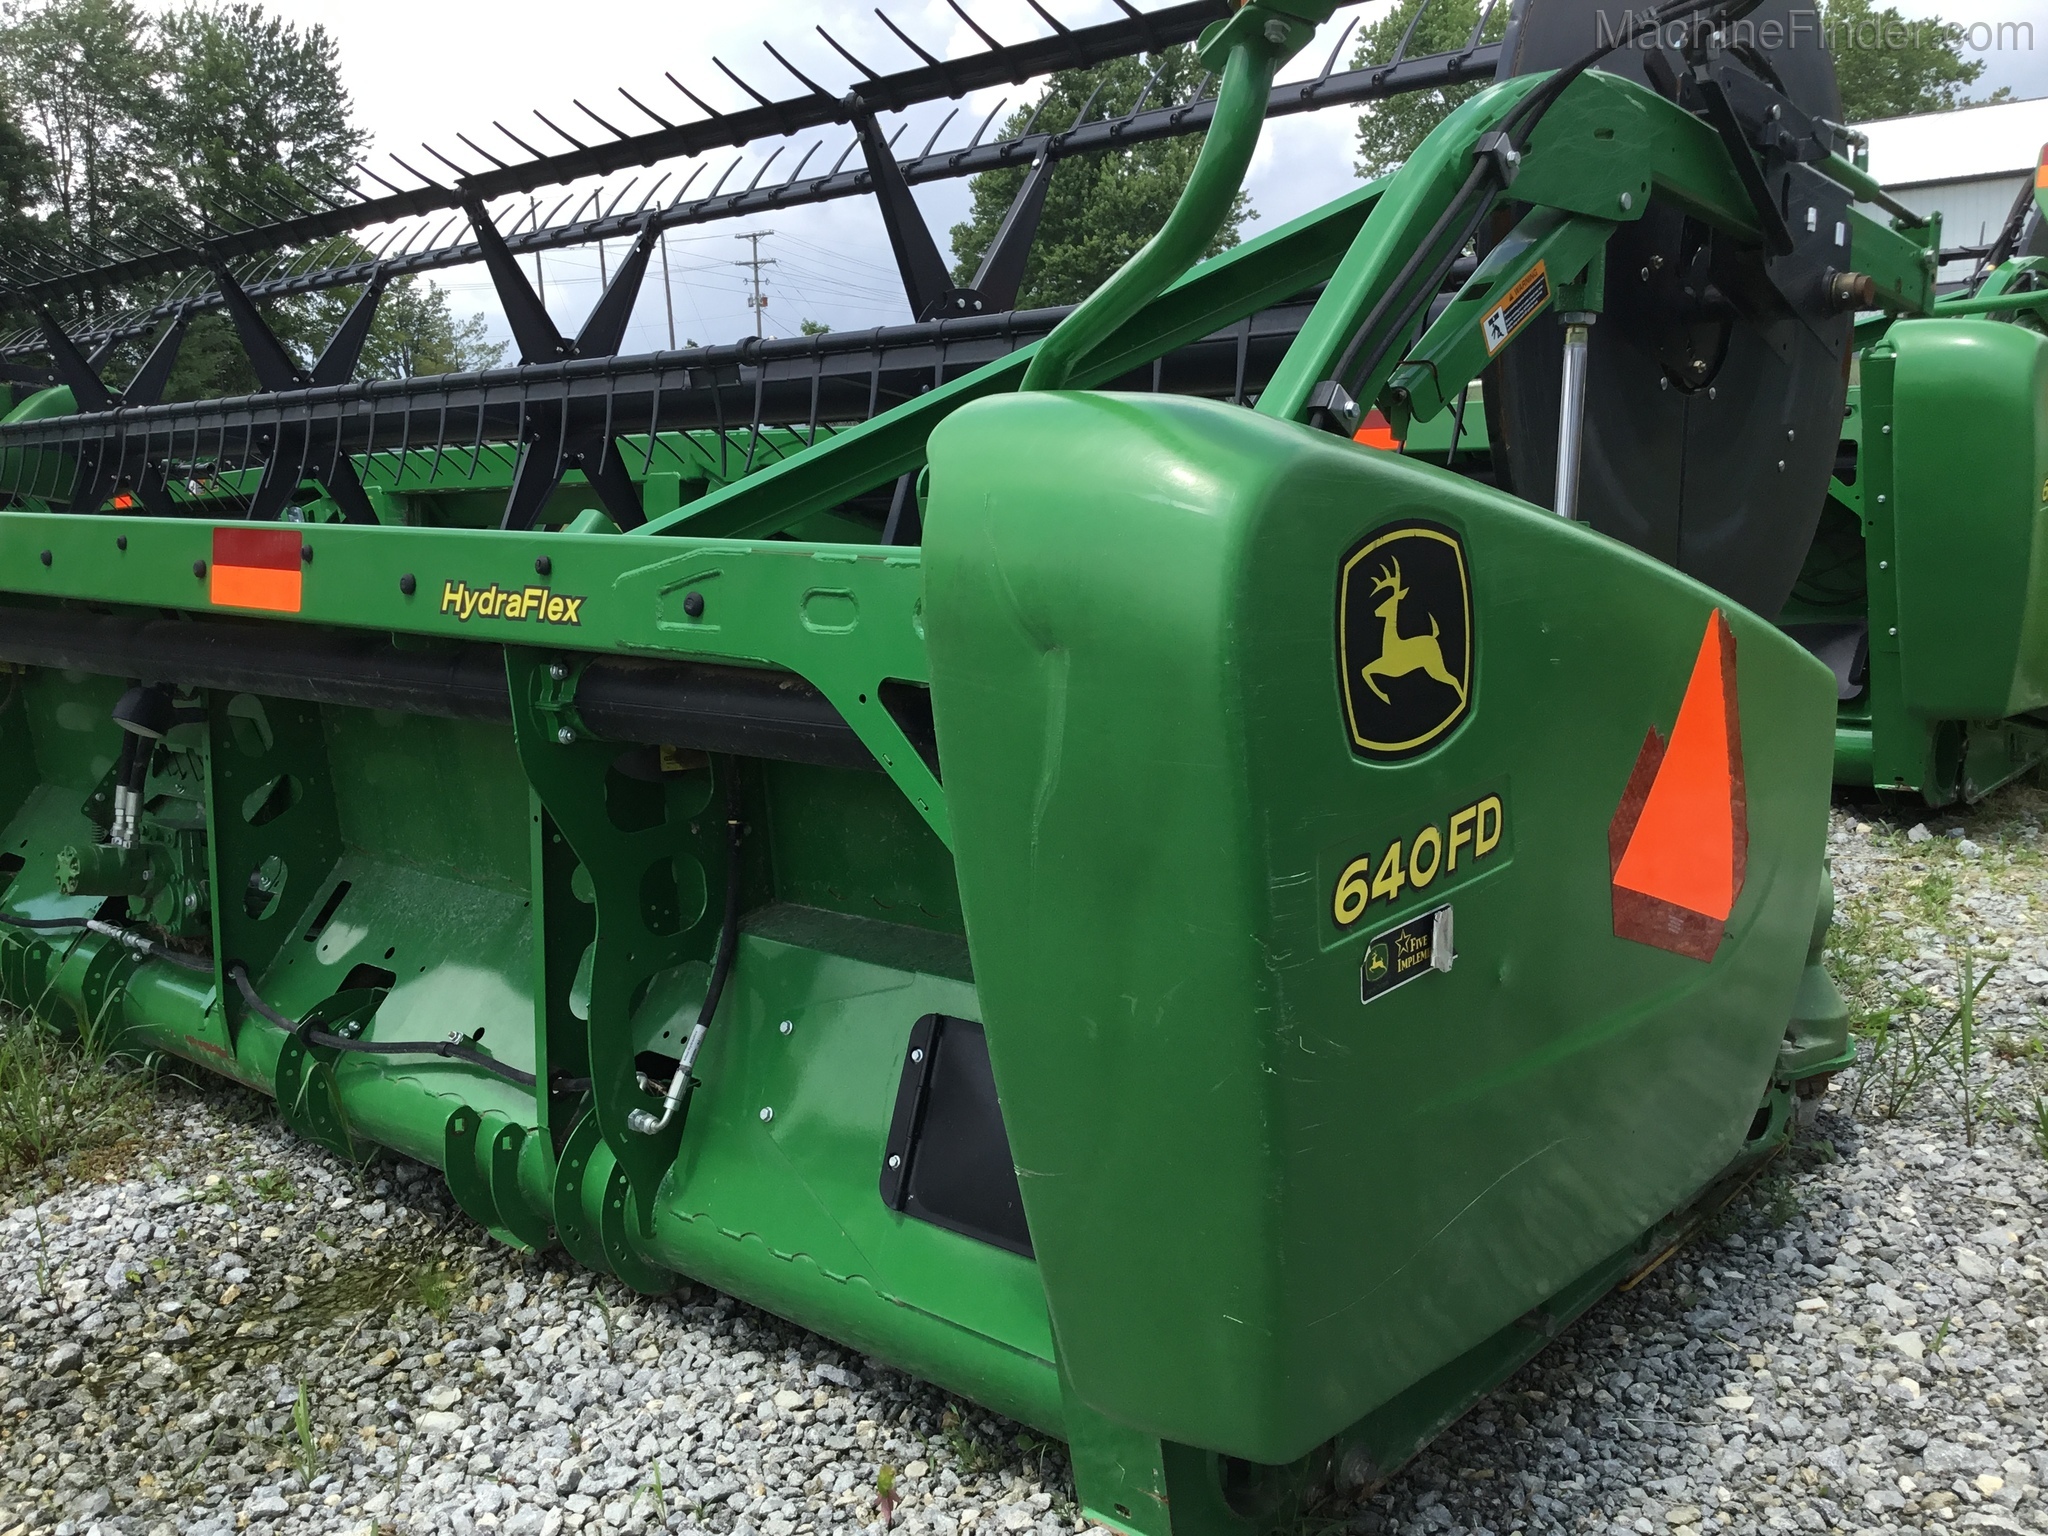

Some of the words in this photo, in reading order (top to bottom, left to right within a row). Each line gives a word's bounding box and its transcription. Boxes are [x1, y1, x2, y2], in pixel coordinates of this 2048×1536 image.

[1514, 268, 1538, 295] WARNING
[441, 581, 585, 624] HydraFlex
[1333, 794, 1502, 927] 640FD
